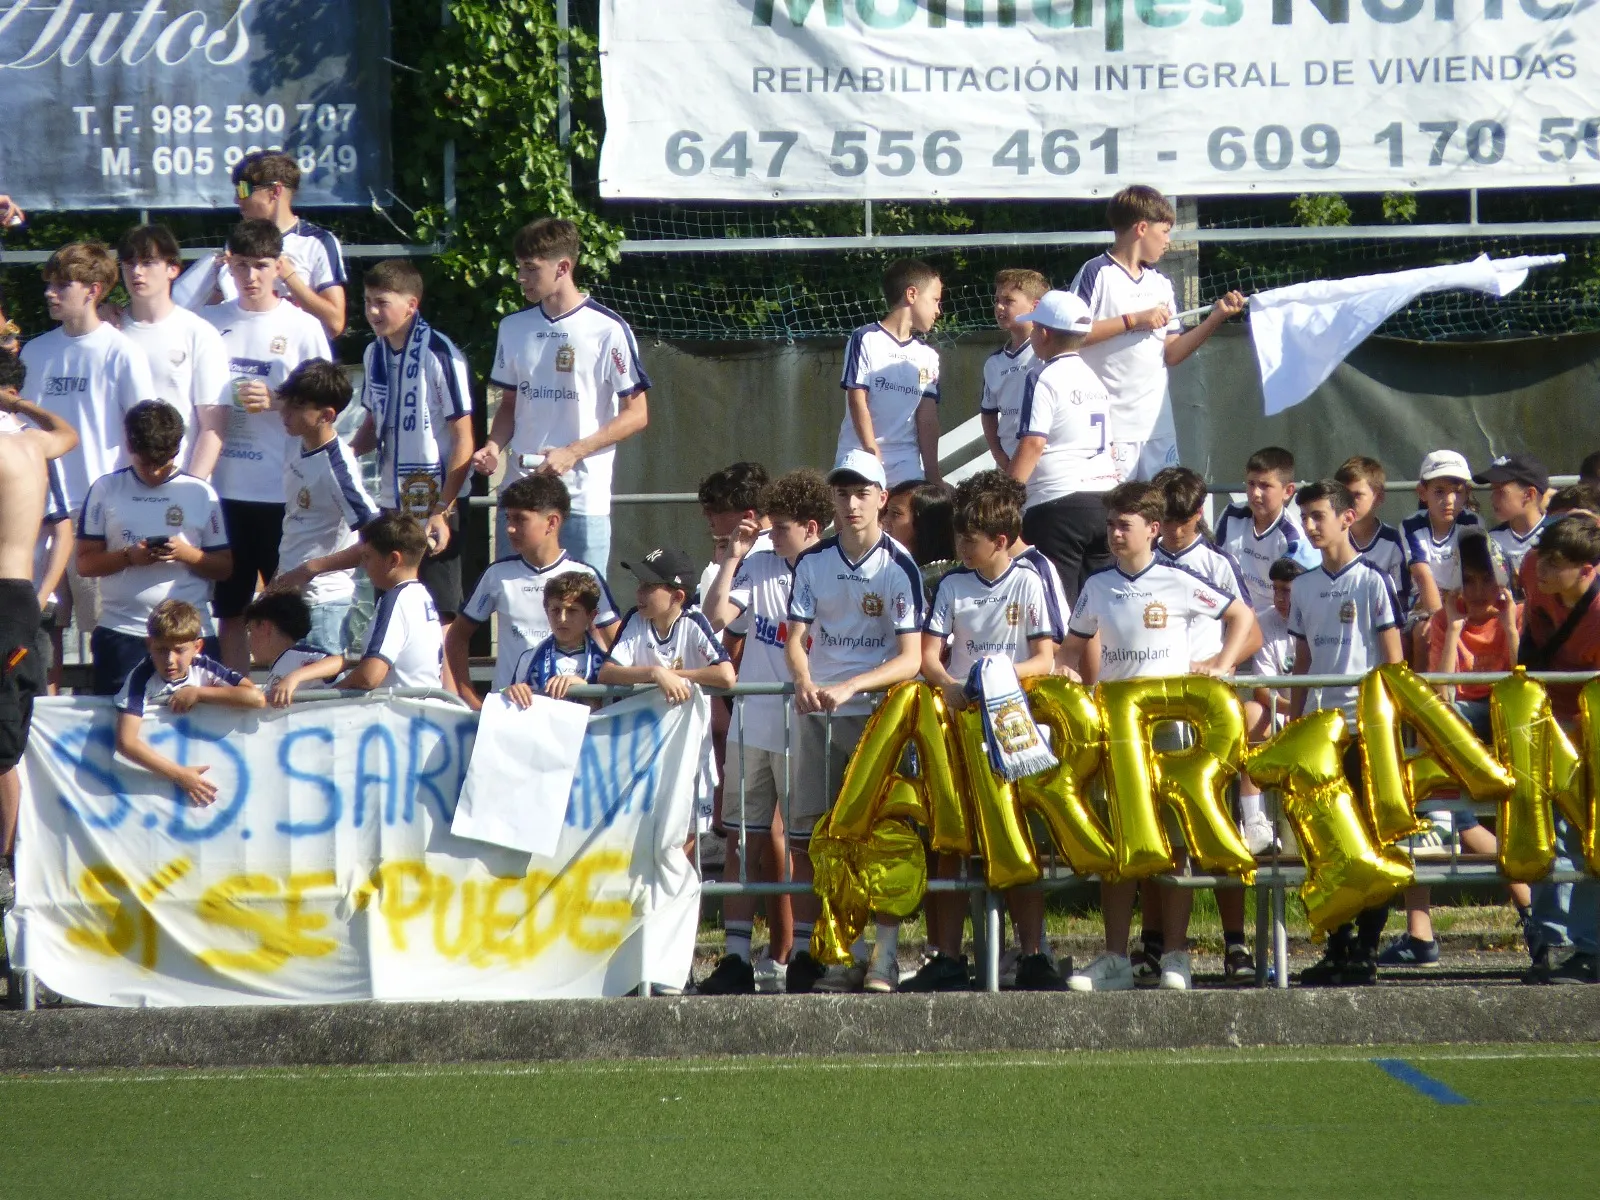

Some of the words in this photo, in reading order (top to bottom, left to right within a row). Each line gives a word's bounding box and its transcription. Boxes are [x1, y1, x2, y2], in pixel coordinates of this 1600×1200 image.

[752, 60, 1078, 93] REHABILITACIÓN
[1095, 61, 1290, 91] INTEGRAL
[1304, 59, 1354, 86] DE
[1368, 53, 1578, 84] VIVIENDAS
[72, 105, 100, 135] T.
[113, 105, 141, 134] F.
[151, 104, 213, 134] 982
[224, 103, 285, 133] 530
[296, 103, 357, 132] 707
[101, 147, 142, 176] M.
[152, 147, 214, 175] 605
[298, 144, 358, 174] 849
[665, 129, 799, 178] 647
[828, 129, 963, 177] 556
[992, 127, 1119, 175] 461
[1207, 123, 1341, 171] 609
[1374, 119, 1506, 168] 170
[837, 573, 870, 584] GIVOVA
[1116, 591, 1152, 600] GIVOVA
[196, 870, 338, 975] SE
